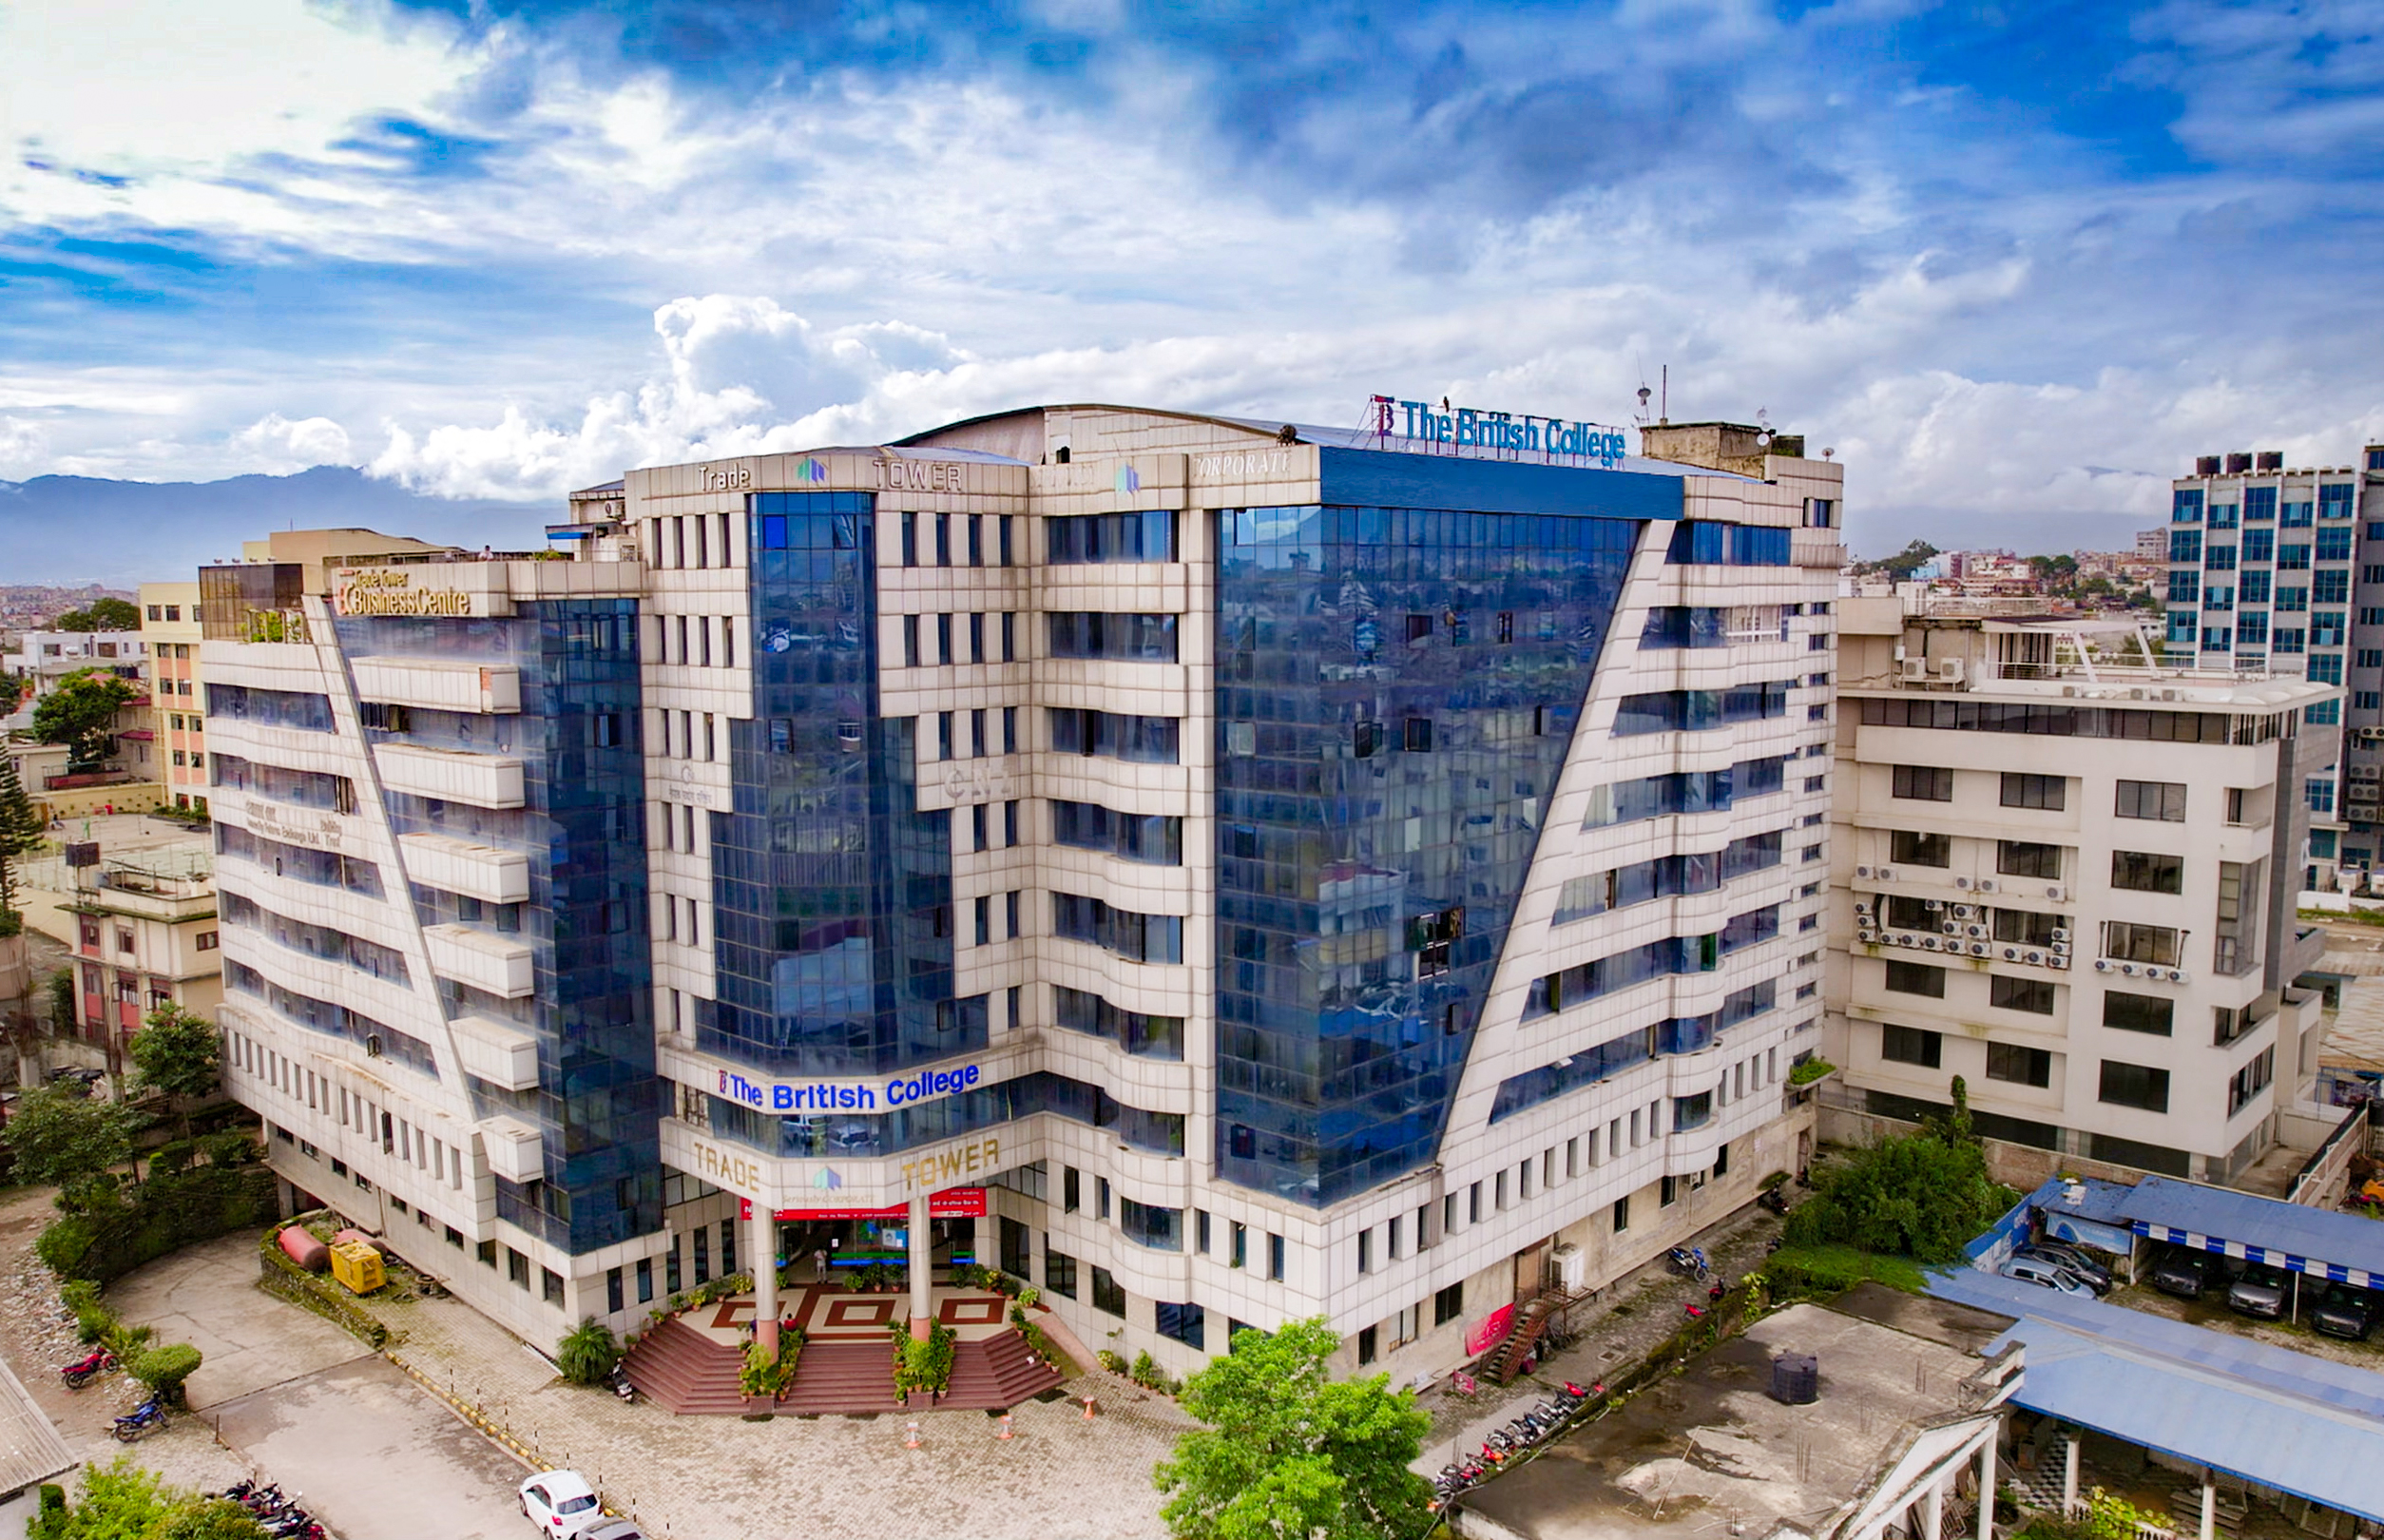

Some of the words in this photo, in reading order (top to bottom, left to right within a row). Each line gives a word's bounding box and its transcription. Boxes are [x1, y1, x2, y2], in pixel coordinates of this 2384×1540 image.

[1400, 400, 1452, 443] The
[1457, 408, 1539, 451] British
[1546, 419, 1625, 467] College
[699, 462, 751, 491] Trade
[873, 459, 962, 491] TOWER
[356, 568, 380, 587] Trade
[381, 568, 409, 587] Tower
[354, 587, 416, 615] Business
[417, 585, 471, 615] Centre
[730, 1073, 763, 1107] The
[773, 1084, 875, 1109] British
[887, 1065, 979, 1105] College
[694, 1142, 759, 1193] TRADE
[902, 1138, 999, 1191] TOWER
